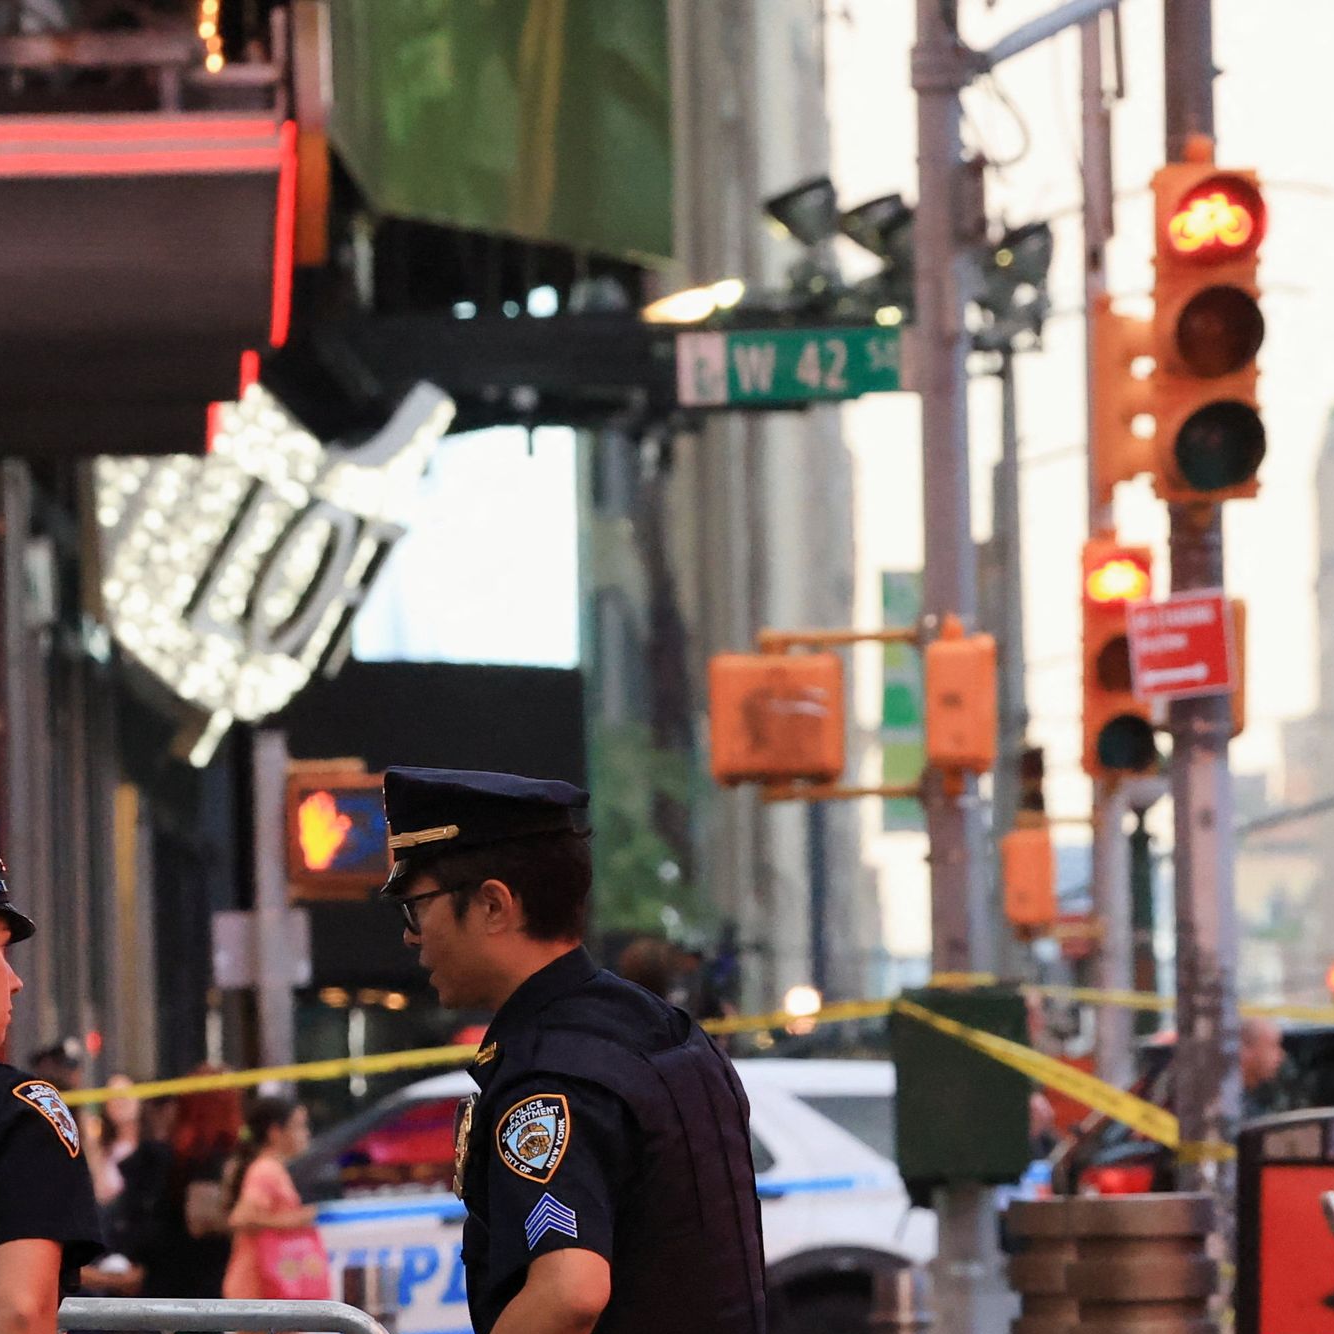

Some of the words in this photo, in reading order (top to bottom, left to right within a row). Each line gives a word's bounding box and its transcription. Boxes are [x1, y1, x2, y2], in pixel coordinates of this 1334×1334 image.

[733, 342, 776, 393] W
[796, 339, 849, 392] 42
[502, 1106, 560, 1143] DEPARTMENT
[509, 1100, 543, 1124] POLICE
[546, 1147, 561, 1169] NEW
[555, 1118, 566, 1146] YORK
[504, 1151, 520, 1167] CITY
[519, 1165, 533, 1174] OF
